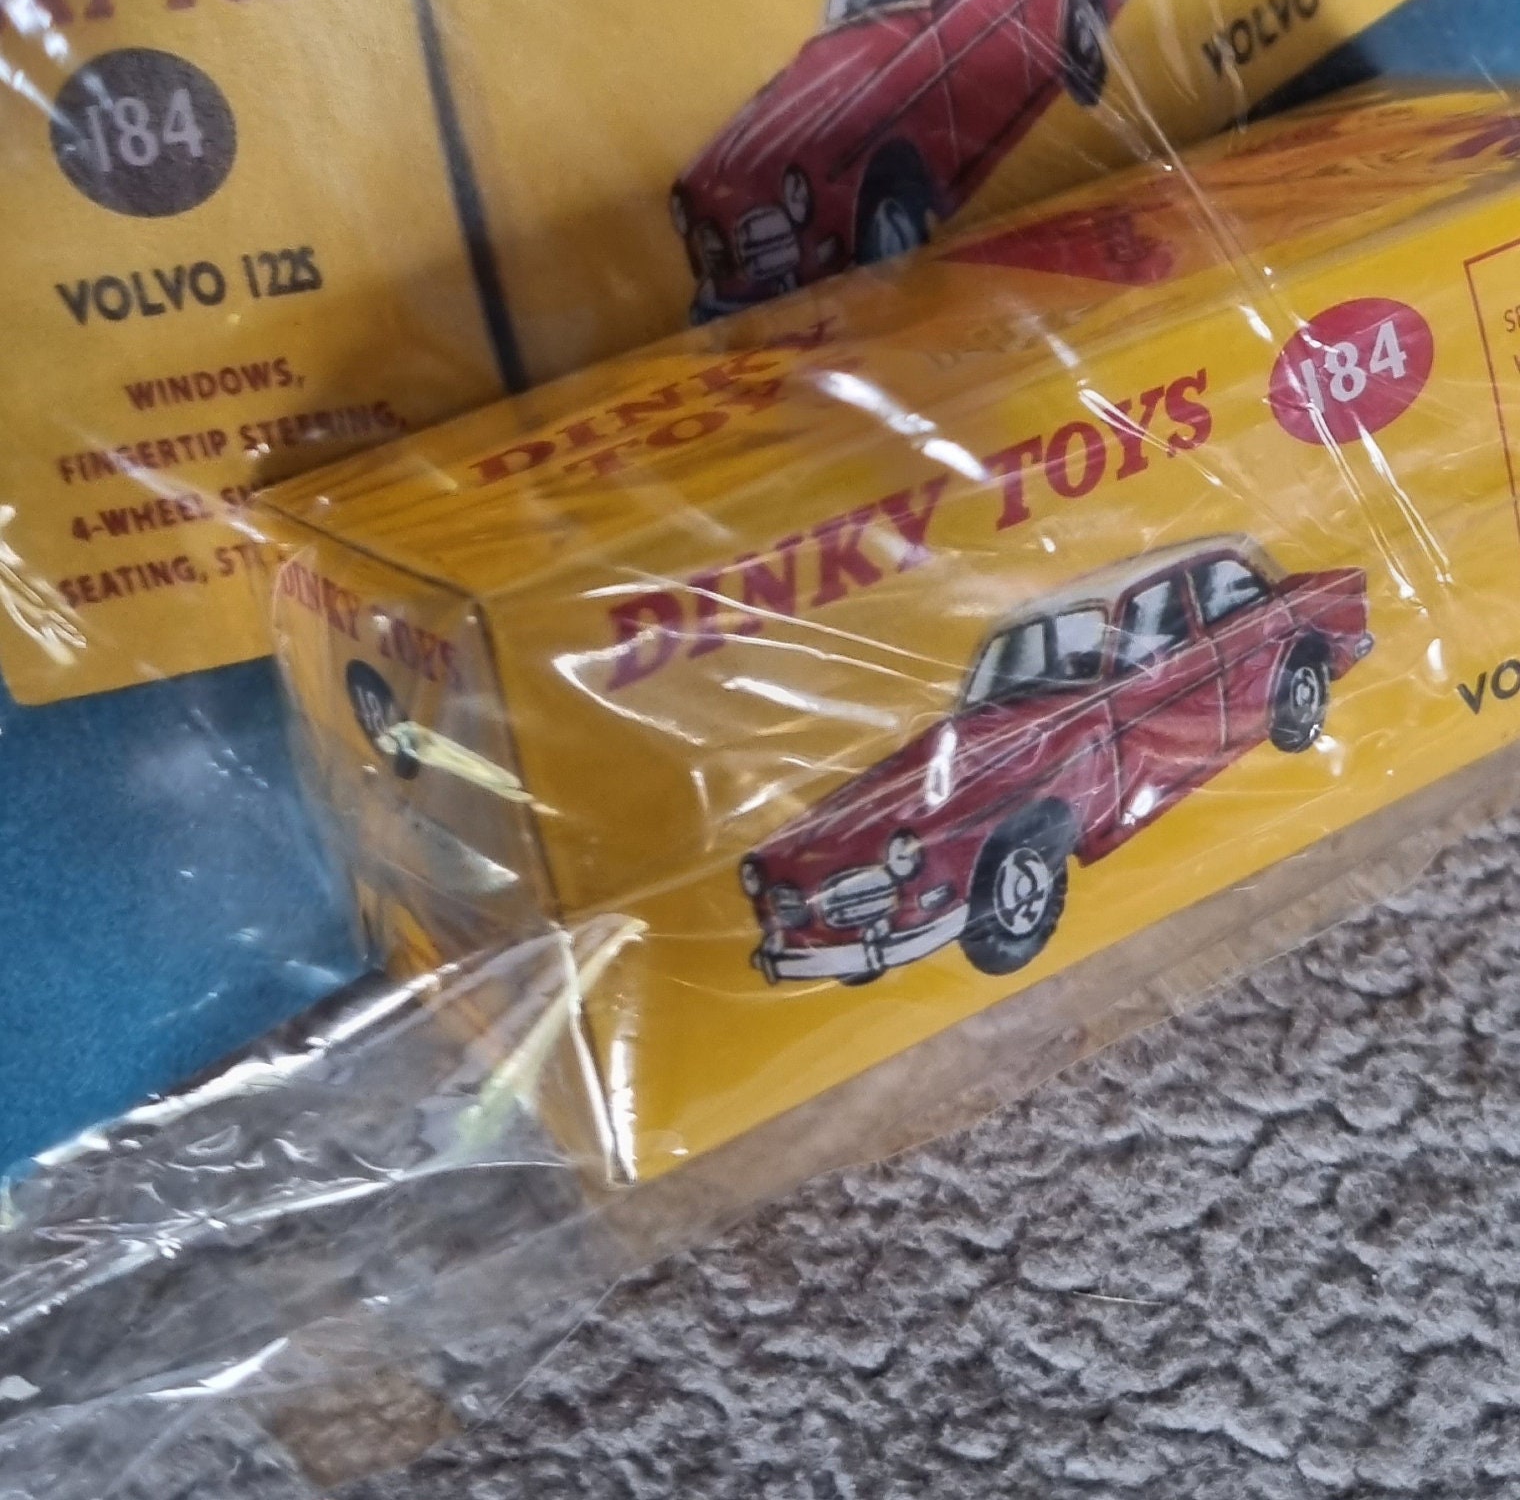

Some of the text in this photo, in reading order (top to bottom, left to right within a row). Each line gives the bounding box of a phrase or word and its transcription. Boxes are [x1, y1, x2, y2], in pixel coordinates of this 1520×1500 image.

[84, 88, 203, 172] 184
[55, 246, 323, 325] VOLVO 122S
[125, 356, 305, 411] WINDOWS,
[468, 316, 838, 486] DINKY
[1302, 320, 1407, 412] 184
[55, 429, 228, 484] FINGERTIP
[605, 369, 1213, 692] DINKY TOYS
[57, 555, 208, 610] SEATING,
